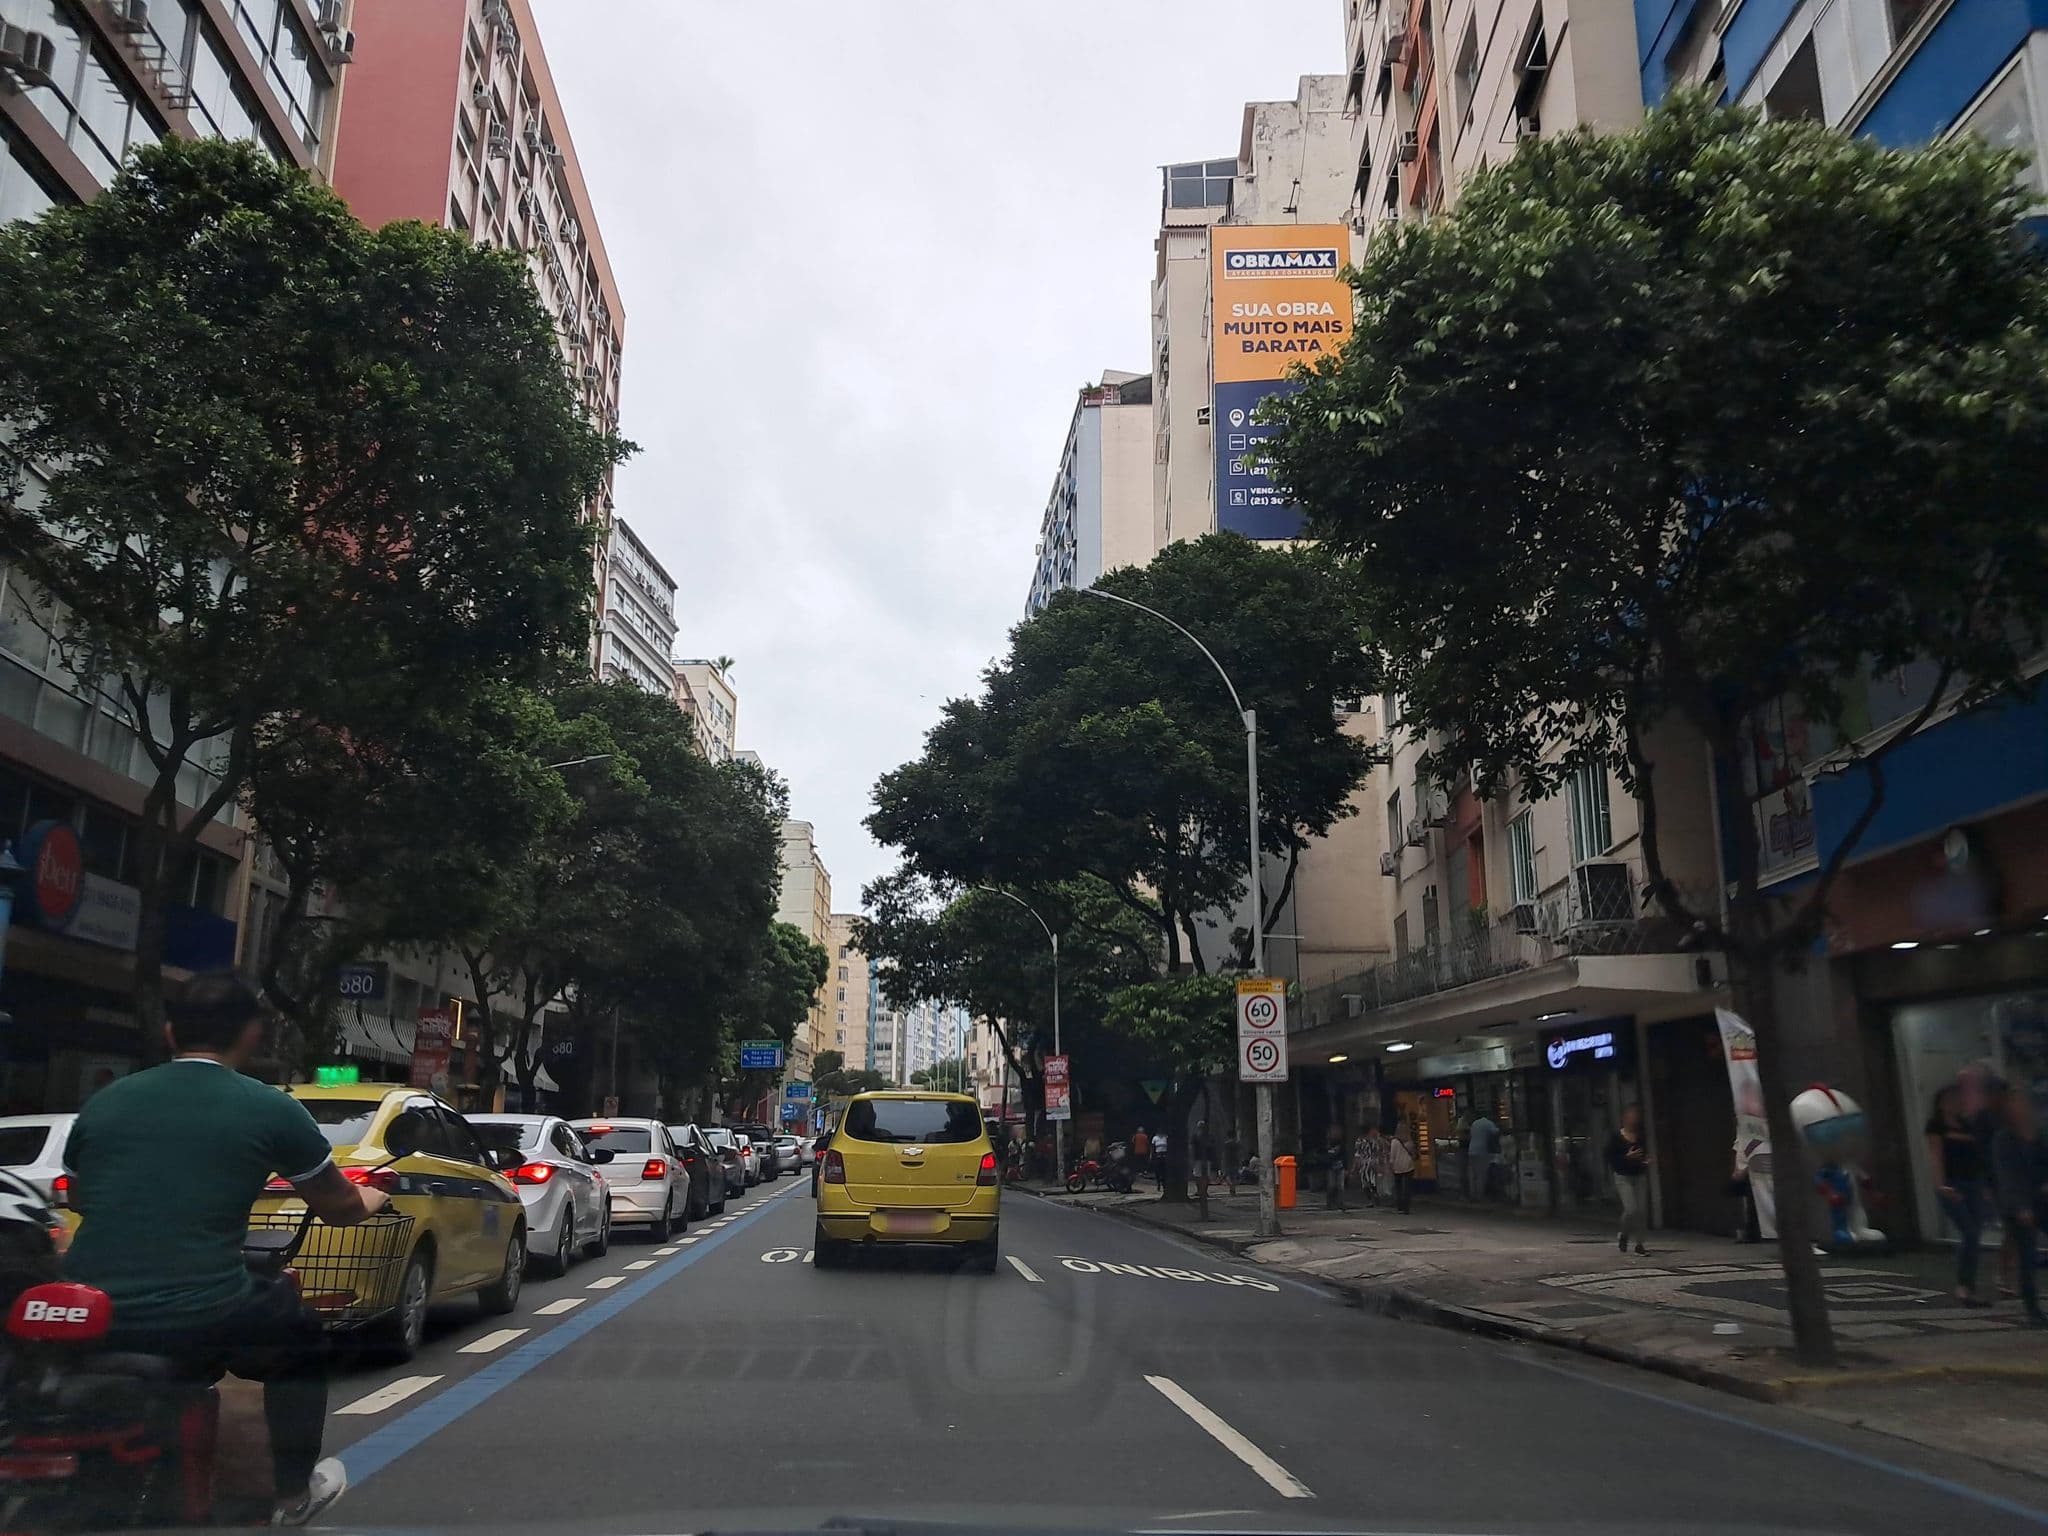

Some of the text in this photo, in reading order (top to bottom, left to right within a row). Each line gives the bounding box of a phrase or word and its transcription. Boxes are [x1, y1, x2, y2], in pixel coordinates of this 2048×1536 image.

[1230, 253, 1332, 268] OBRAMAX
[1232, 302, 1335, 317] SUA OBRA
[1224, 320, 1343, 335] MUITO MAIS
[1242, 339, 1323, 353] BARATA
[1250, 467, 1268, 476] (21)
[1250, 497, 1269, 505] (21)
[1251, 1003, 1271, 1017] 60
[1252, 1046, 1272, 1061] 50
[23, 1300, 90, 1323] Bee
